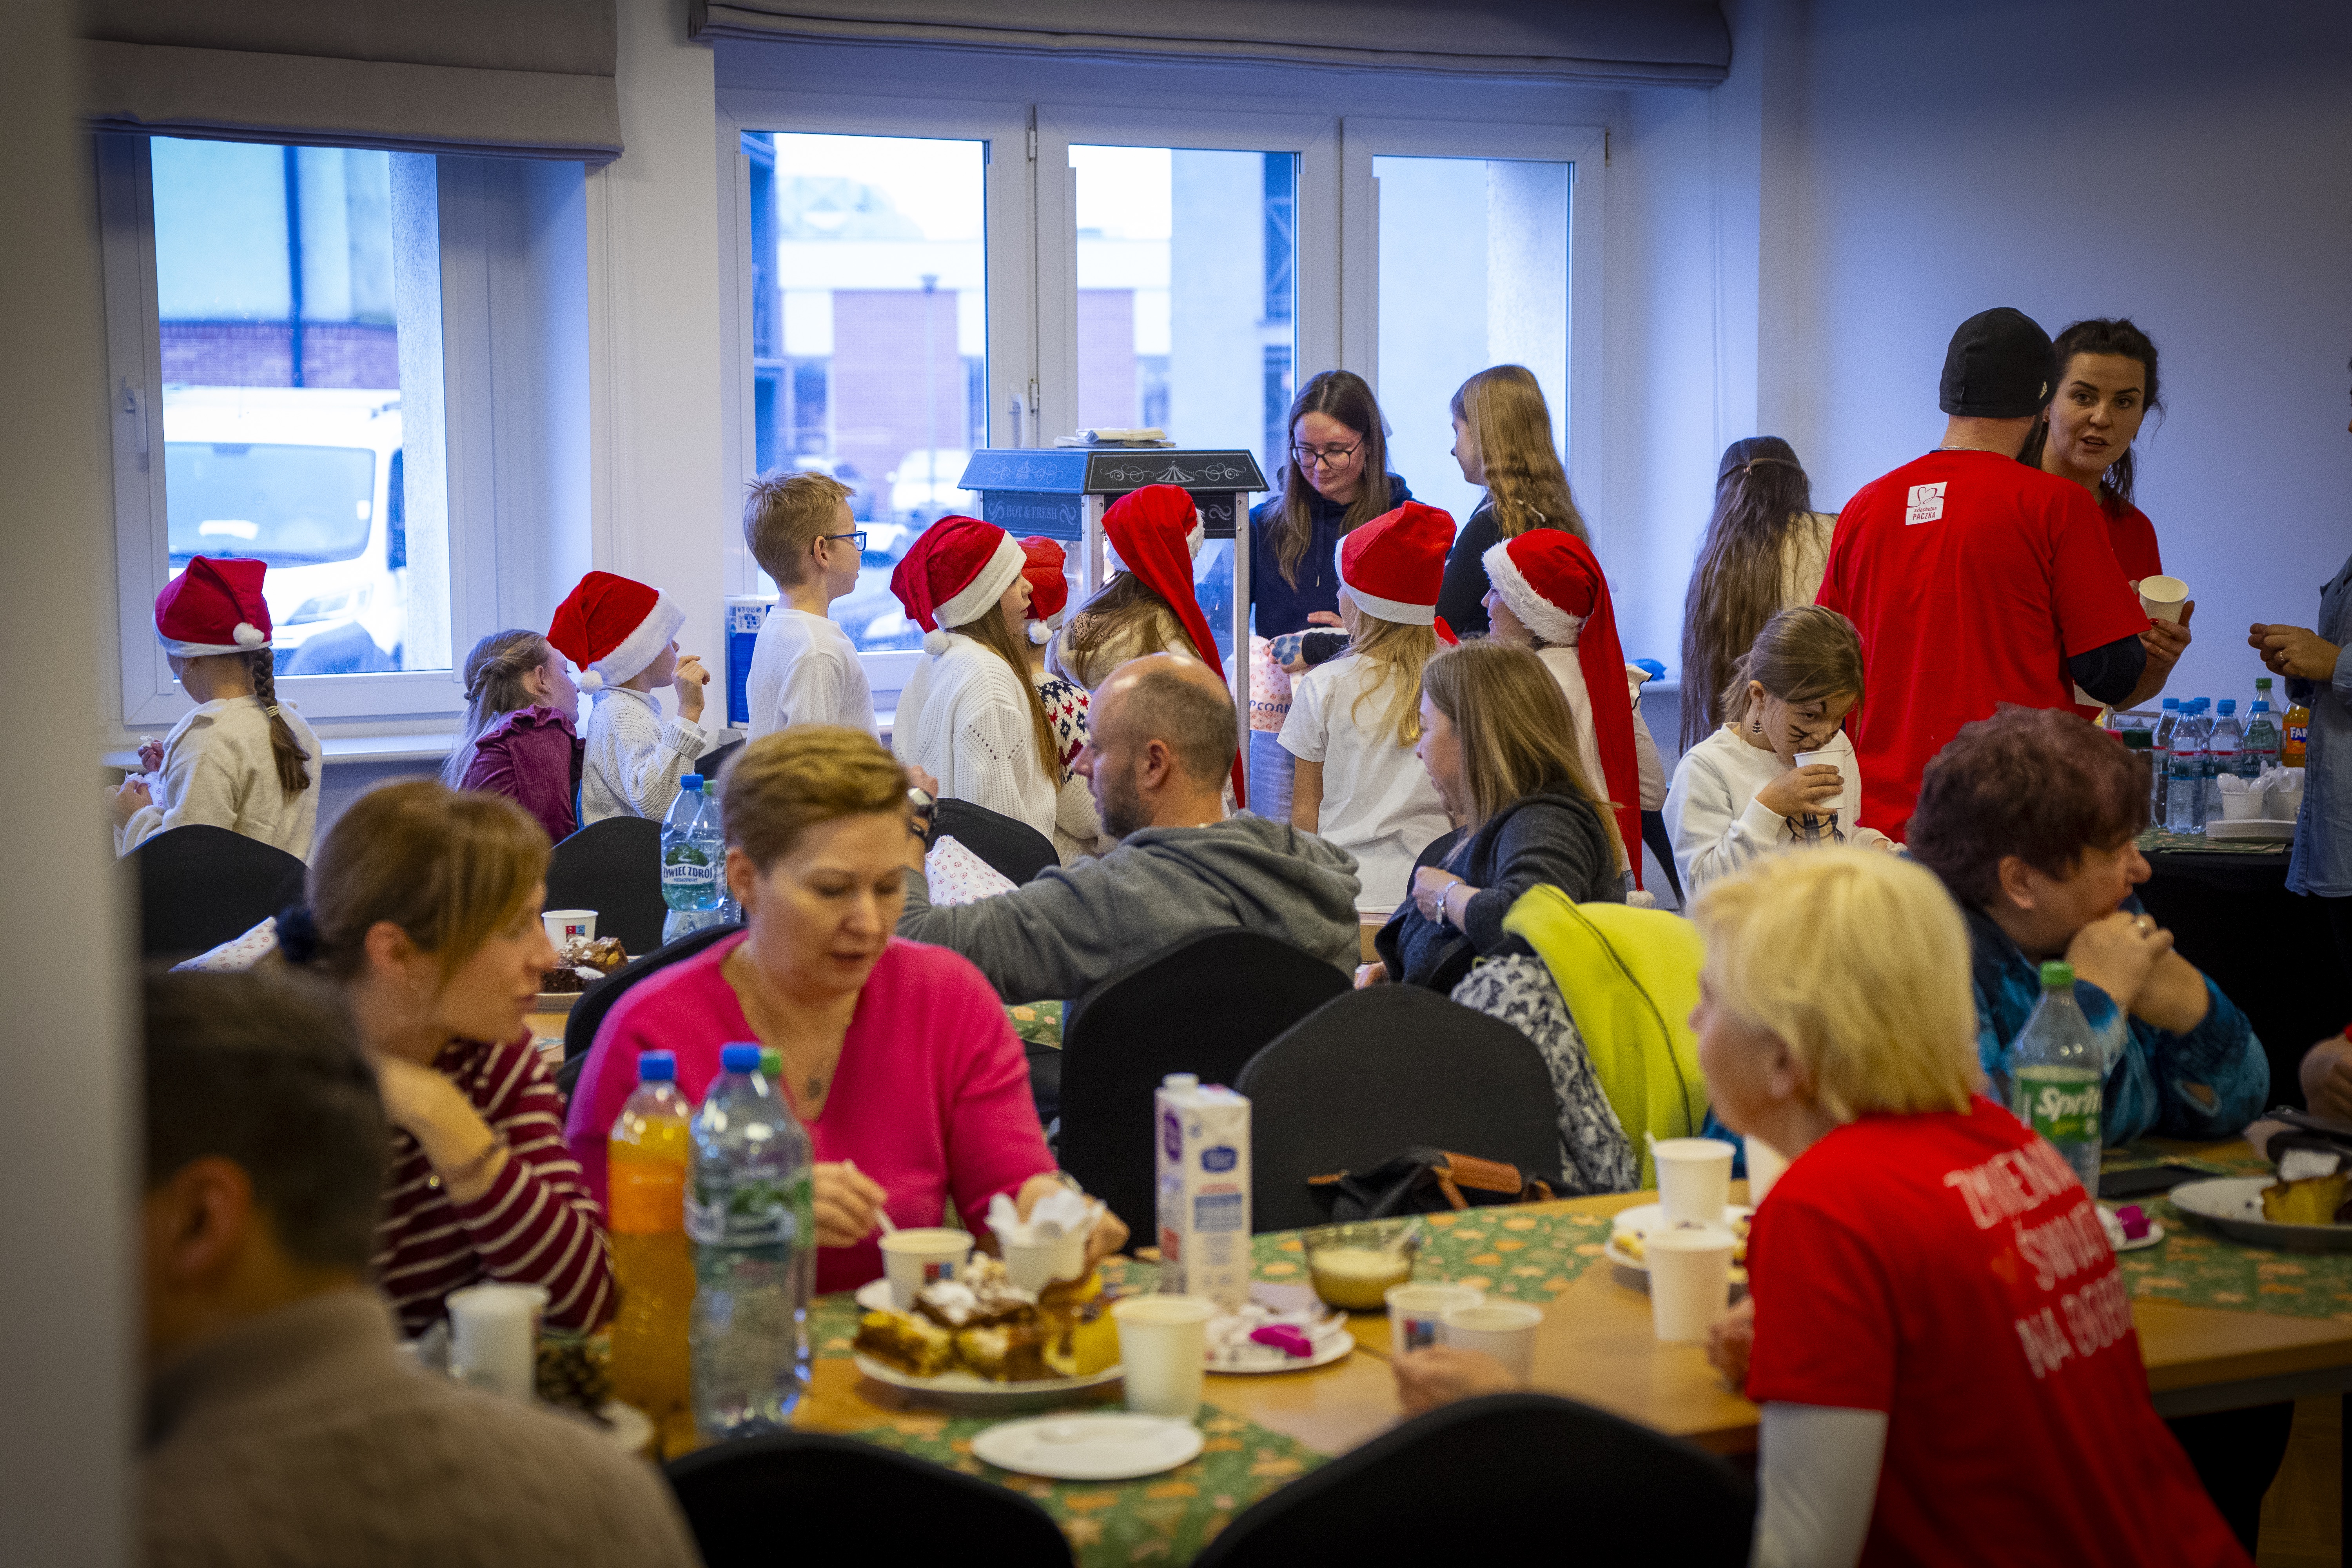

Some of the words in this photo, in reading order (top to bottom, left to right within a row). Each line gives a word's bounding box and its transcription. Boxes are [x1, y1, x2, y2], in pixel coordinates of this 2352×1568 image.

[1007, 505, 1022, 517] HOT
[1024, 506, 1031, 518] &
[1032, 507, 1057, 520] FRESH
[1913, 512, 1936, 520] PACZKA
[1249, 700, 1291, 713] PCORN
[2290, 726, 2308, 739] FAN
[688, 866, 712, 878] ZDRÓJ
